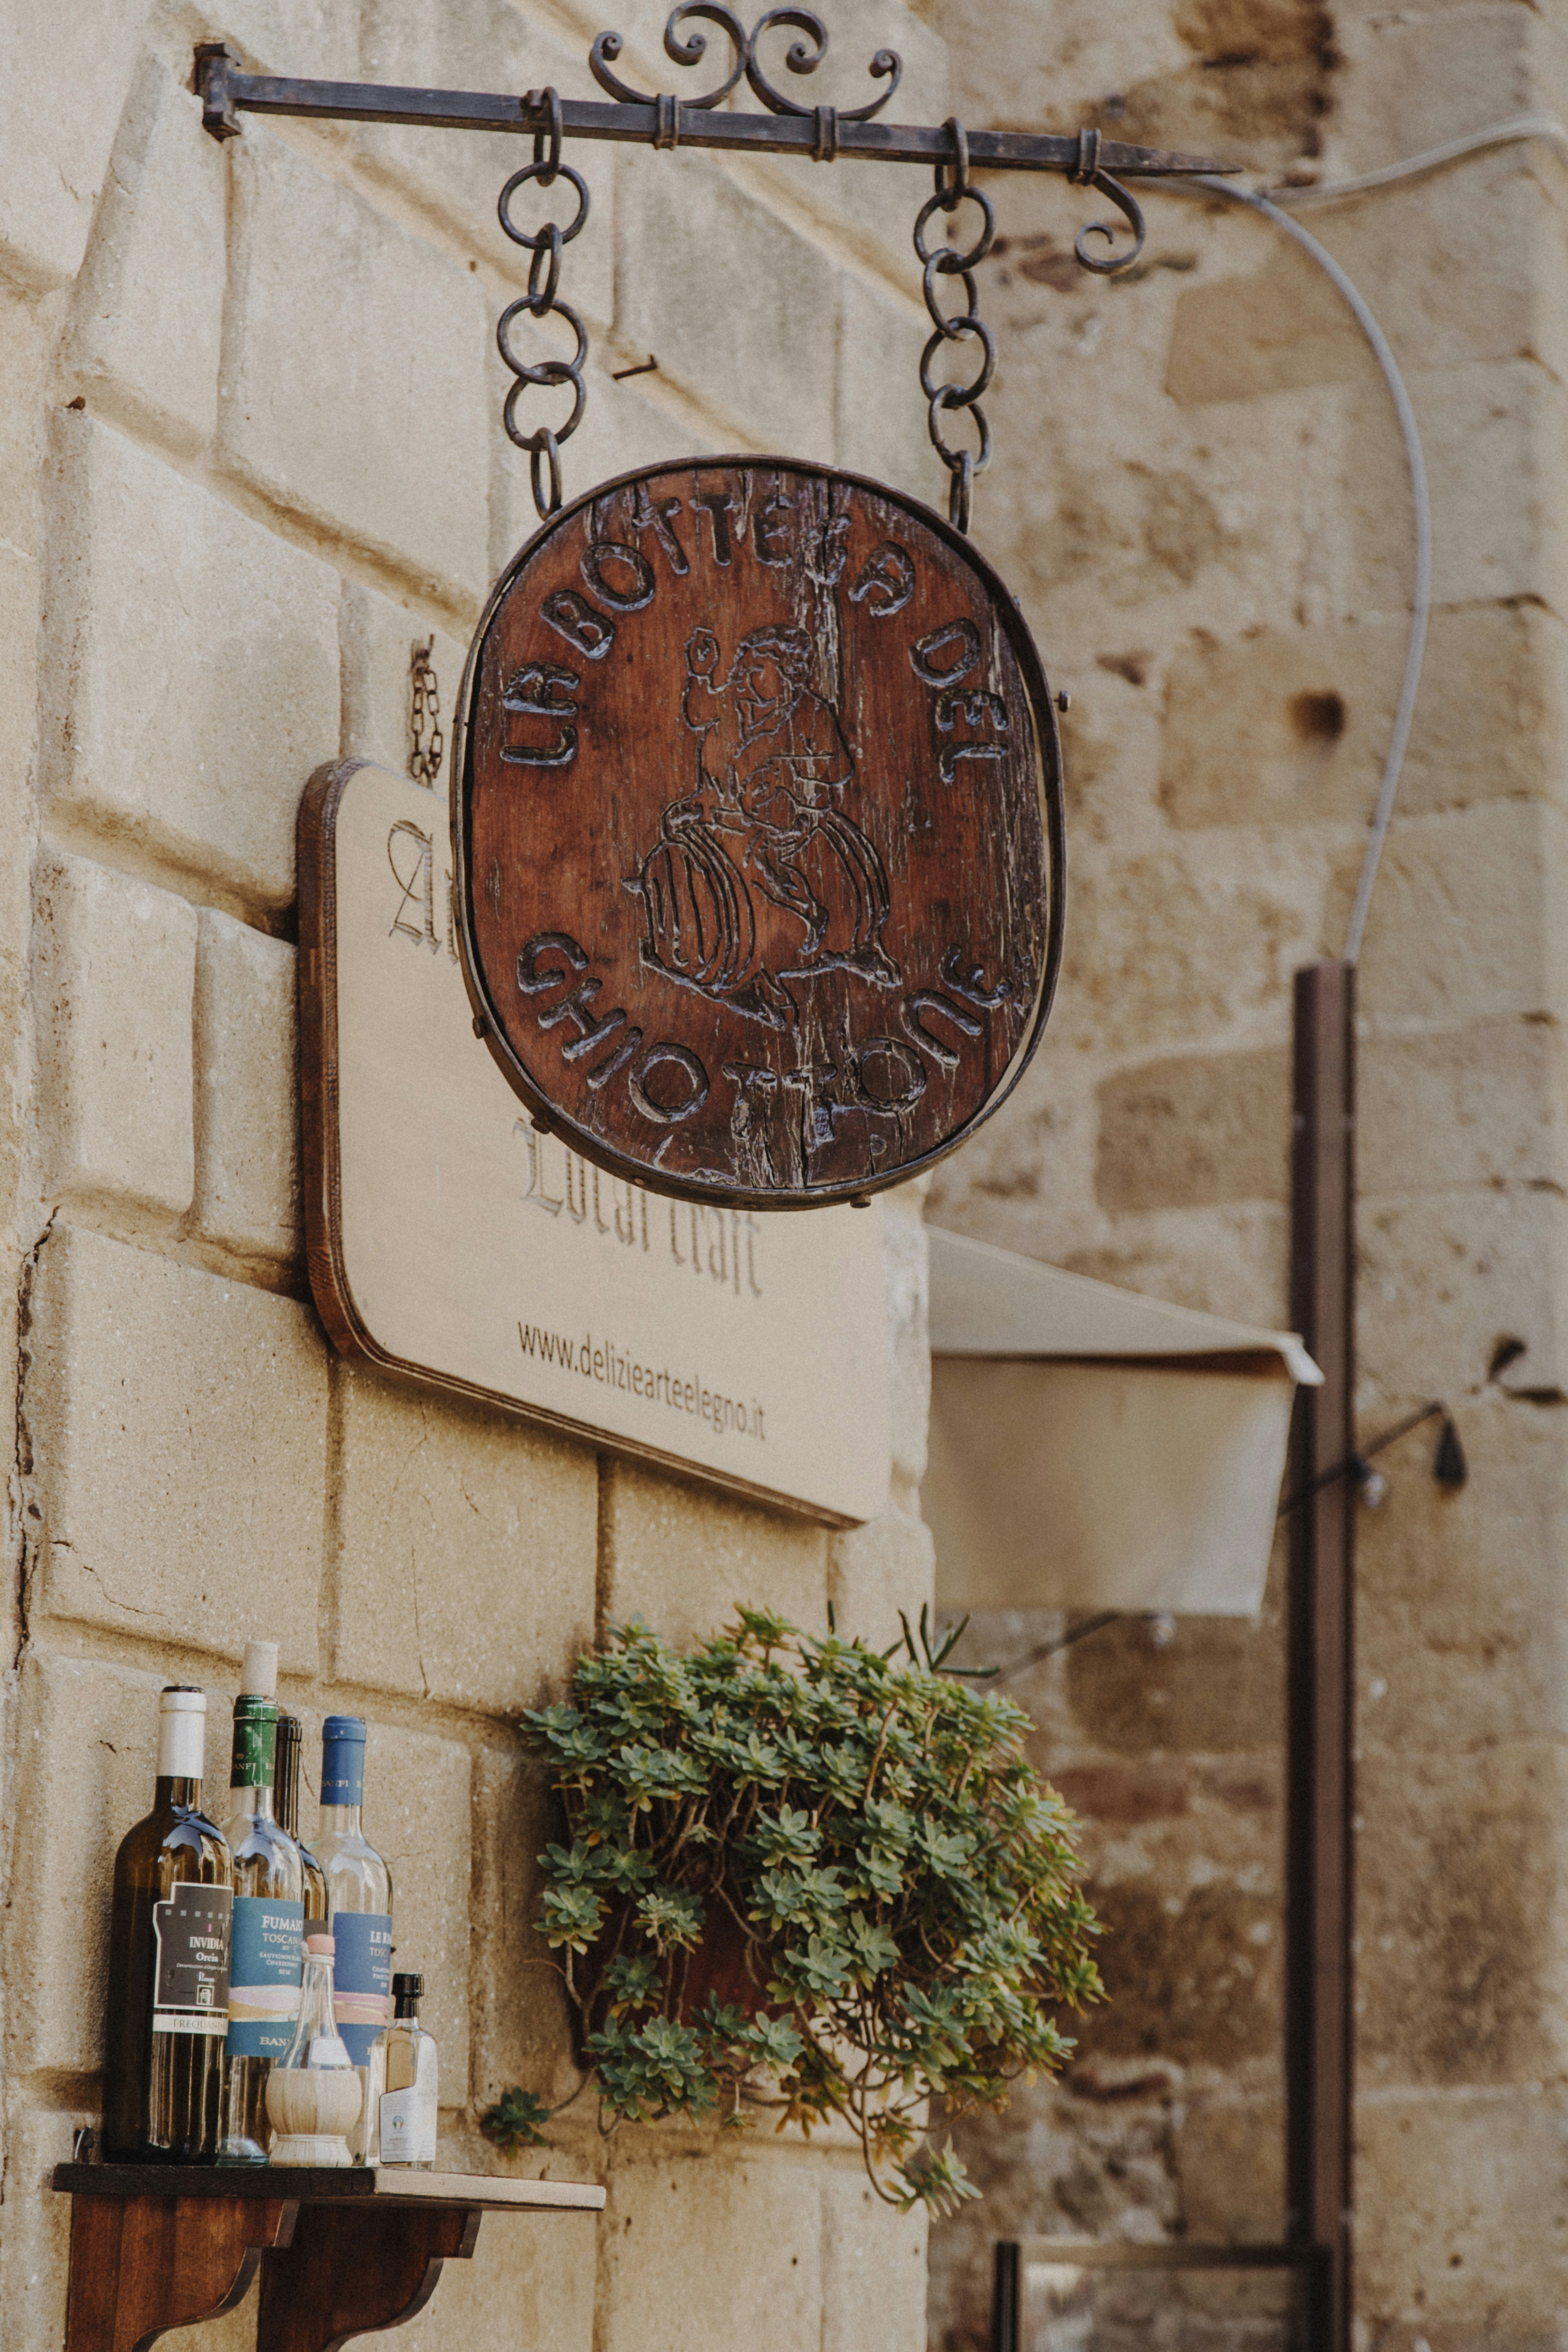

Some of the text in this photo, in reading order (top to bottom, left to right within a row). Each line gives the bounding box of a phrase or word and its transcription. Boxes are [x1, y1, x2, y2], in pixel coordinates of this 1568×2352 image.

[500, 492, 1009, 785] LA BOTTEGA DEL
[517, 931, 1013, 1152] GHIOTTONE
[518, 1321, 766, 1441] www.deliziearteelegno.it
[190, 1936, 223, 1950] INVIDIA
[196, 1952, 218, 1962] Orcia
[370, 1931, 381, 1943] LE
